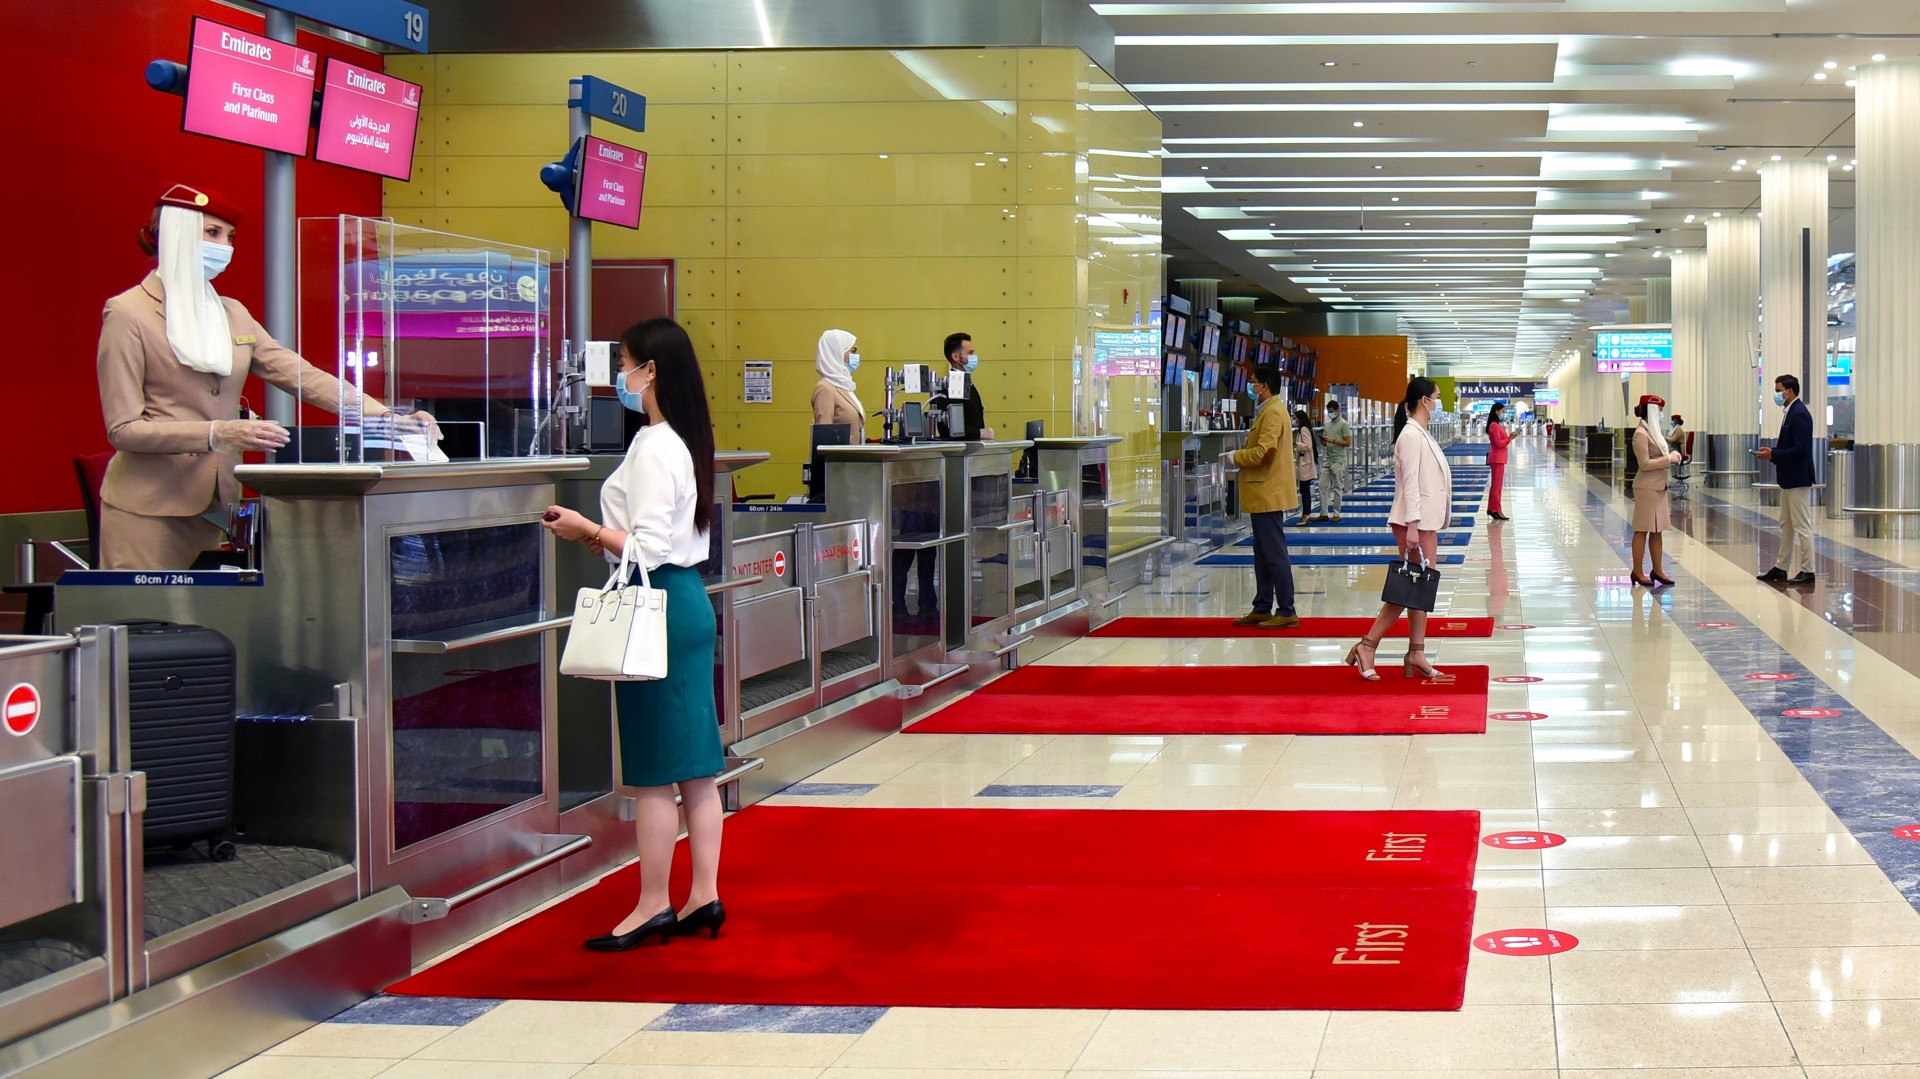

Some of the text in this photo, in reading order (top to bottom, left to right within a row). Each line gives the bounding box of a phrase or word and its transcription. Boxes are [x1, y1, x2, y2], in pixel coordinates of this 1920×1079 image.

[404, 11, 423, 42] 19
[221, 31, 273, 61] Emirates
[232, 81, 275, 105] First Class
[347, 69, 386, 95] Emirates
[224, 100, 278, 124] and Platinum
[611, 91, 627, 117] 20
[368, 118, 391, 135] الدرجة
[599, 145, 624, 161] Emirates
[603, 179, 624, 192] First Class
[1482, 386, 1521, 394] SARASIN
[753, 558, 774, 575] ENTER
[134, 574, 162, 585] 60cm
[171, 574, 194, 585] 24in
[1409, 705, 1450, 720] First
[1365, 831, 1428, 861] First
[1332, 921, 1409, 965] First
